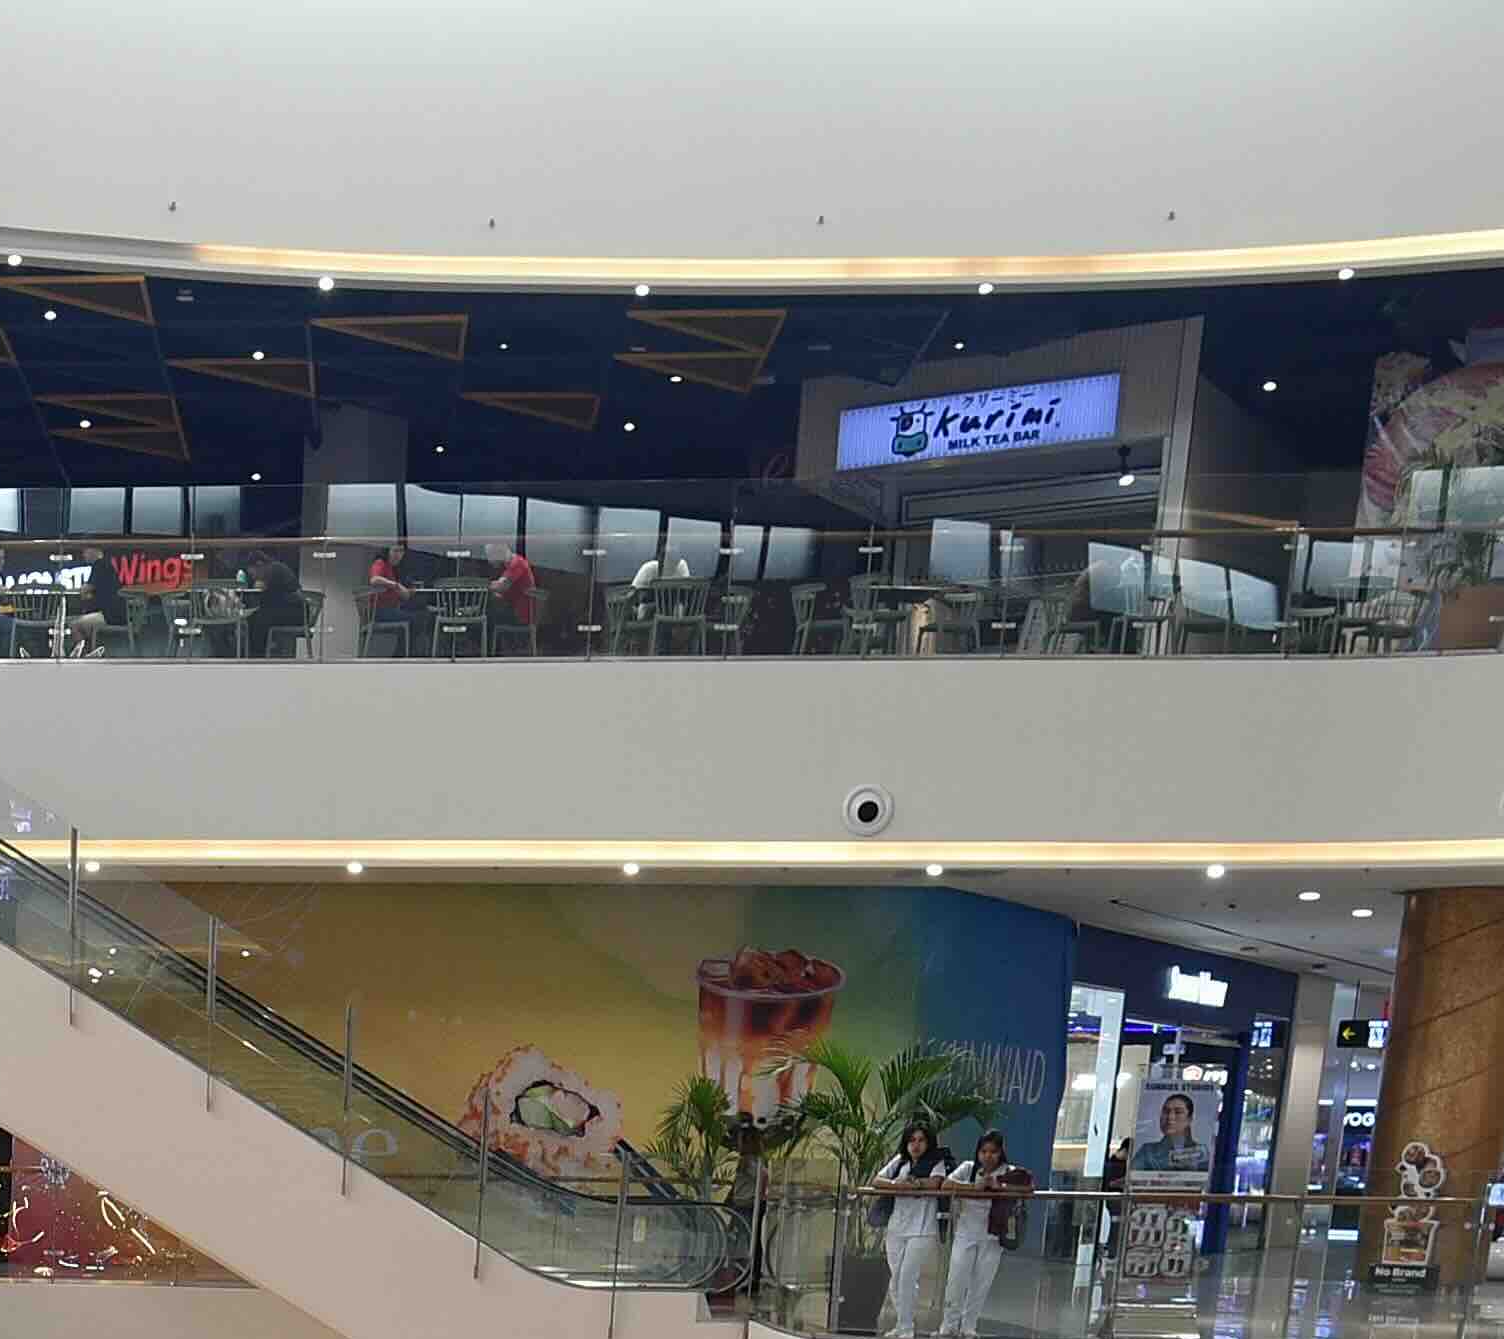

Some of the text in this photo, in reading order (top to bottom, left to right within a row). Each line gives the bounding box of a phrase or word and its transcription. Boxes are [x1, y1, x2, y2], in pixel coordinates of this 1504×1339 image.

[948, 429, 1040, 451] MILK TEA BAR
